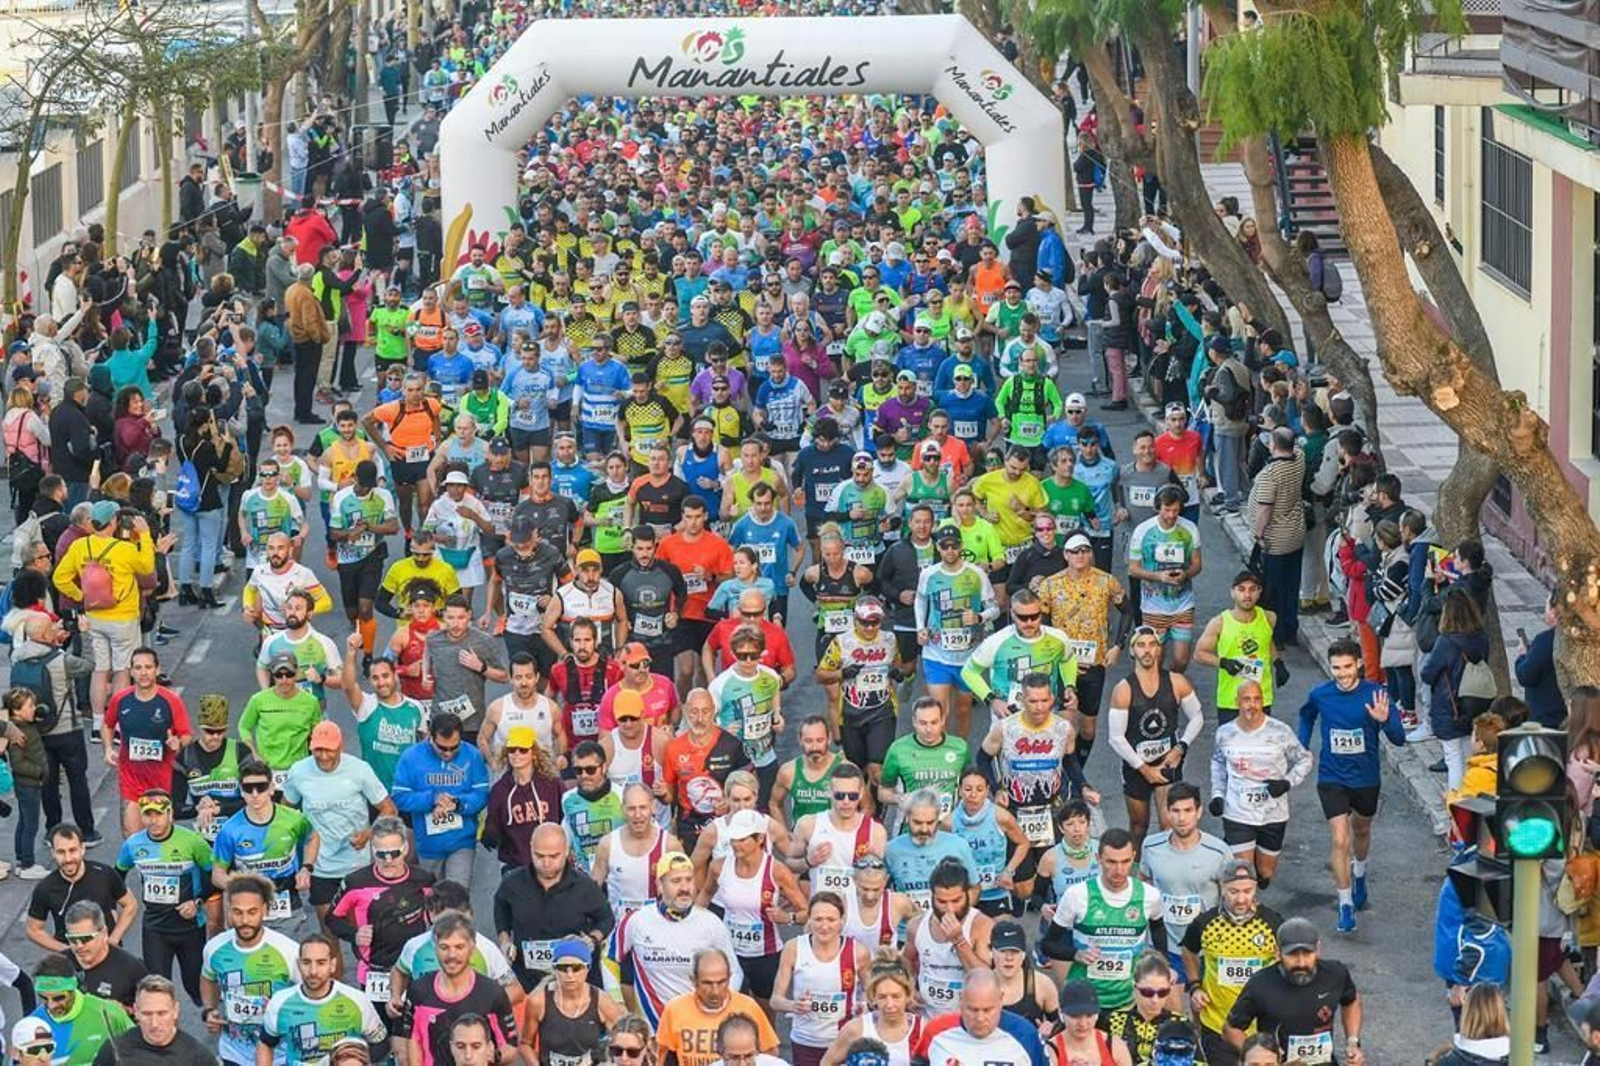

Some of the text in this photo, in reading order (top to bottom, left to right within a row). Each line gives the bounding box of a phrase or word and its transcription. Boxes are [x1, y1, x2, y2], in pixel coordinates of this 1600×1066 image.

[628, 50, 870, 87] Manantiales
[485, 69, 551, 142] Manantiales
[945, 66, 1017, 133] Manantiales
[813, 467, 842, 476] POLAR
[1133, 493, 1151, 501] 210
[850, 551, 872, 560] 1019
[513, 600, 529, 610] 467
[641, 620, 658, 630] 904
[830, 616, 848, 626] 903
[945, 635, 967, 644] 1291
[1333, 737, 1361, 747] 1218
[133, 745, 160, 757] 1323
[914, 769, 954, 782] mijas
[1246, 793, 1269, 802] 739
[512, 801, 550, 824] GAP
[825, 876, 850, 888] 503
[147, 884, 176, 895] 1012
[1169, 904, 1192, 916] 476
[1095, 927, 1137, 935] ATLETISMO
[1097, 960, 1124, 971] 292
[1225, 966, 1253, 978] 888
[929, 986, 954, 1000] 953
[234, 1003, 258, 1015] 847
[812, 1001, 838, 1013] 866
[1298, 1044, 1323, 1056] 631
